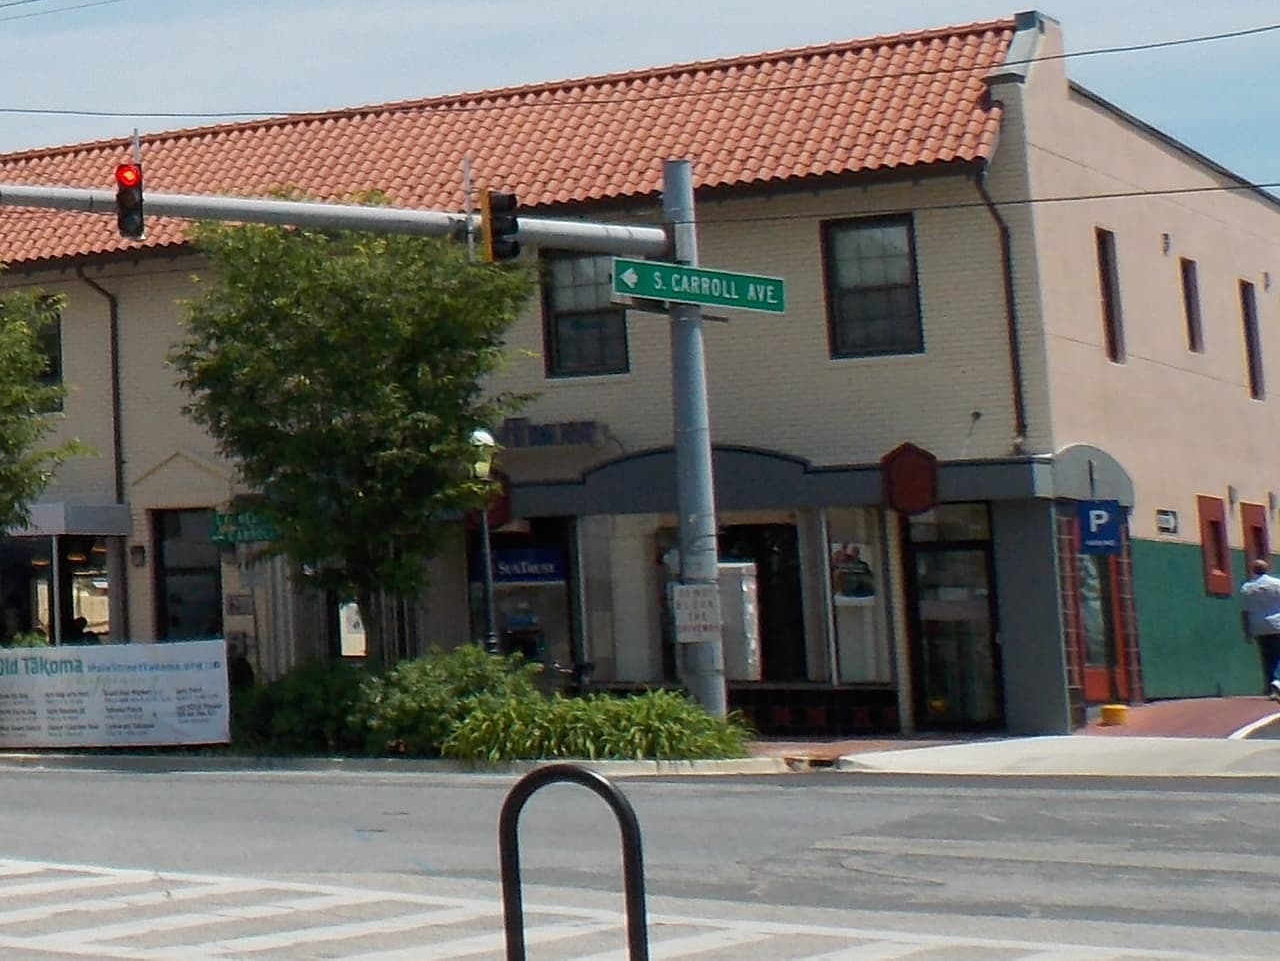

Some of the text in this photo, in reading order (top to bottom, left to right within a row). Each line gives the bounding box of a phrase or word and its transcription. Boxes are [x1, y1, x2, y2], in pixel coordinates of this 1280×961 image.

[653, 272, 667, 290] S.
[671, 274, 739, 299] CARROLL
[1088, 509, 1110, 533] P
